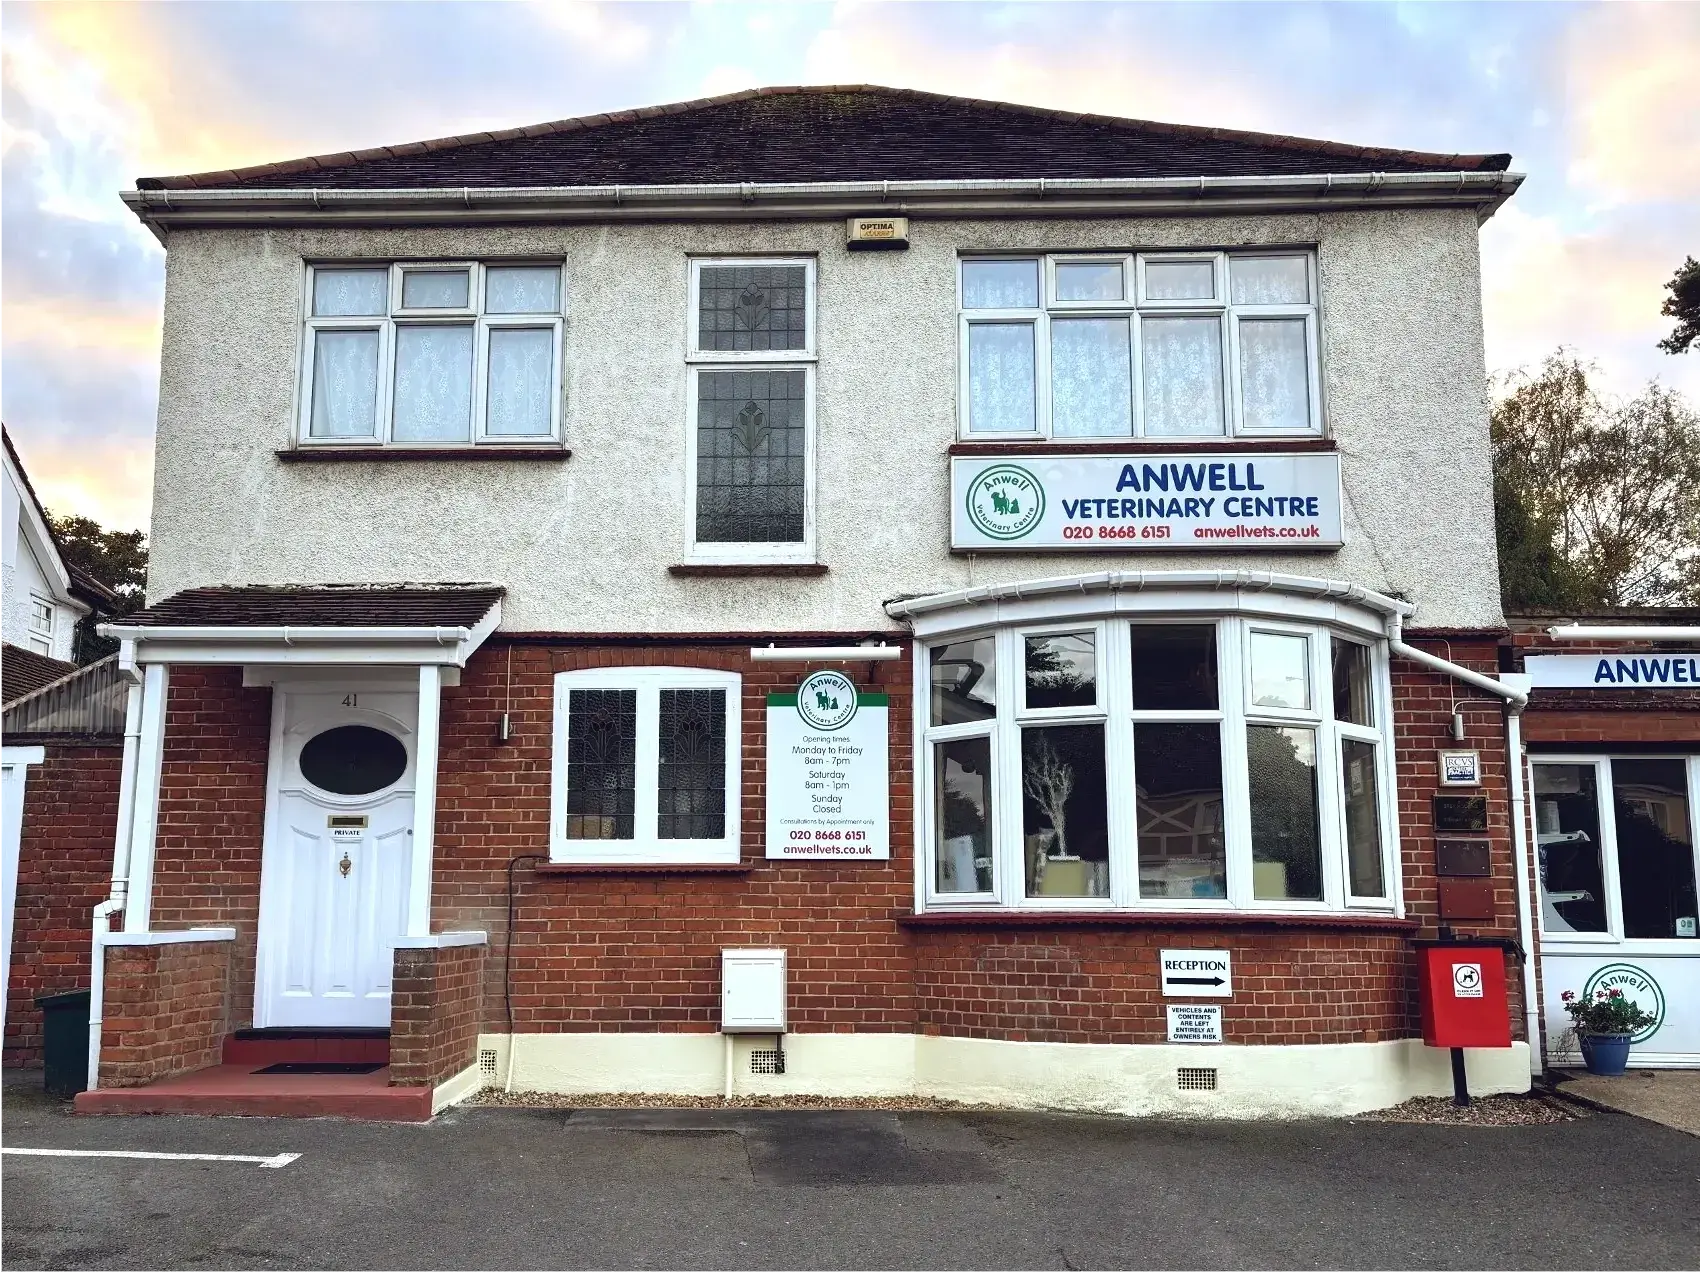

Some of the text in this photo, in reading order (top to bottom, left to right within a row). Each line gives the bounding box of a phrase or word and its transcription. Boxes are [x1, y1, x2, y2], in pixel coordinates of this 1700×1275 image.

[1115, 462, 1265, 492] ANWELL
[983, 475, 1030, 492] Anwell
[1061, 496, 1320, 520] VETERINARY CENTRE
[976, 504, 1035, 532] Veterinary Centre
[1062, 524, 1320, 540] 020 8668 6151 anwellvets.co.uk
[810, 678, 847, 691] Anwell
[341, 693, 358, 707] 41
[804, 701, 850, 724] Veterinary Centre
[802, 735, 831, 744] Opening
[791, 745, 863, 756] Monday to Friday
[804, 756, 824, 765] 8am
[831, 756, 851, 766] 7pm
[1448, 758, 1473, 766] RCVS
[808, 770, 846, 780] Saturday
[804, 780, 824, 789] 8am
[832, 780, 850, 791] 1pm
[811, 794, 843, 804] Sunday
[812, 804, 842, 814] Closed
[818, 818, 826, 826] by
[826, 818, 862, 826] Appointment
[862, 818, 875, 826] only
[789, 830, 866, 841] 020 8668 6151
[783, 843, 872, 855] anwellvets.co.uk
[1165, 960, 1226, 971] RECEPTION
[1600, 975, 1649, 992] Anwell
